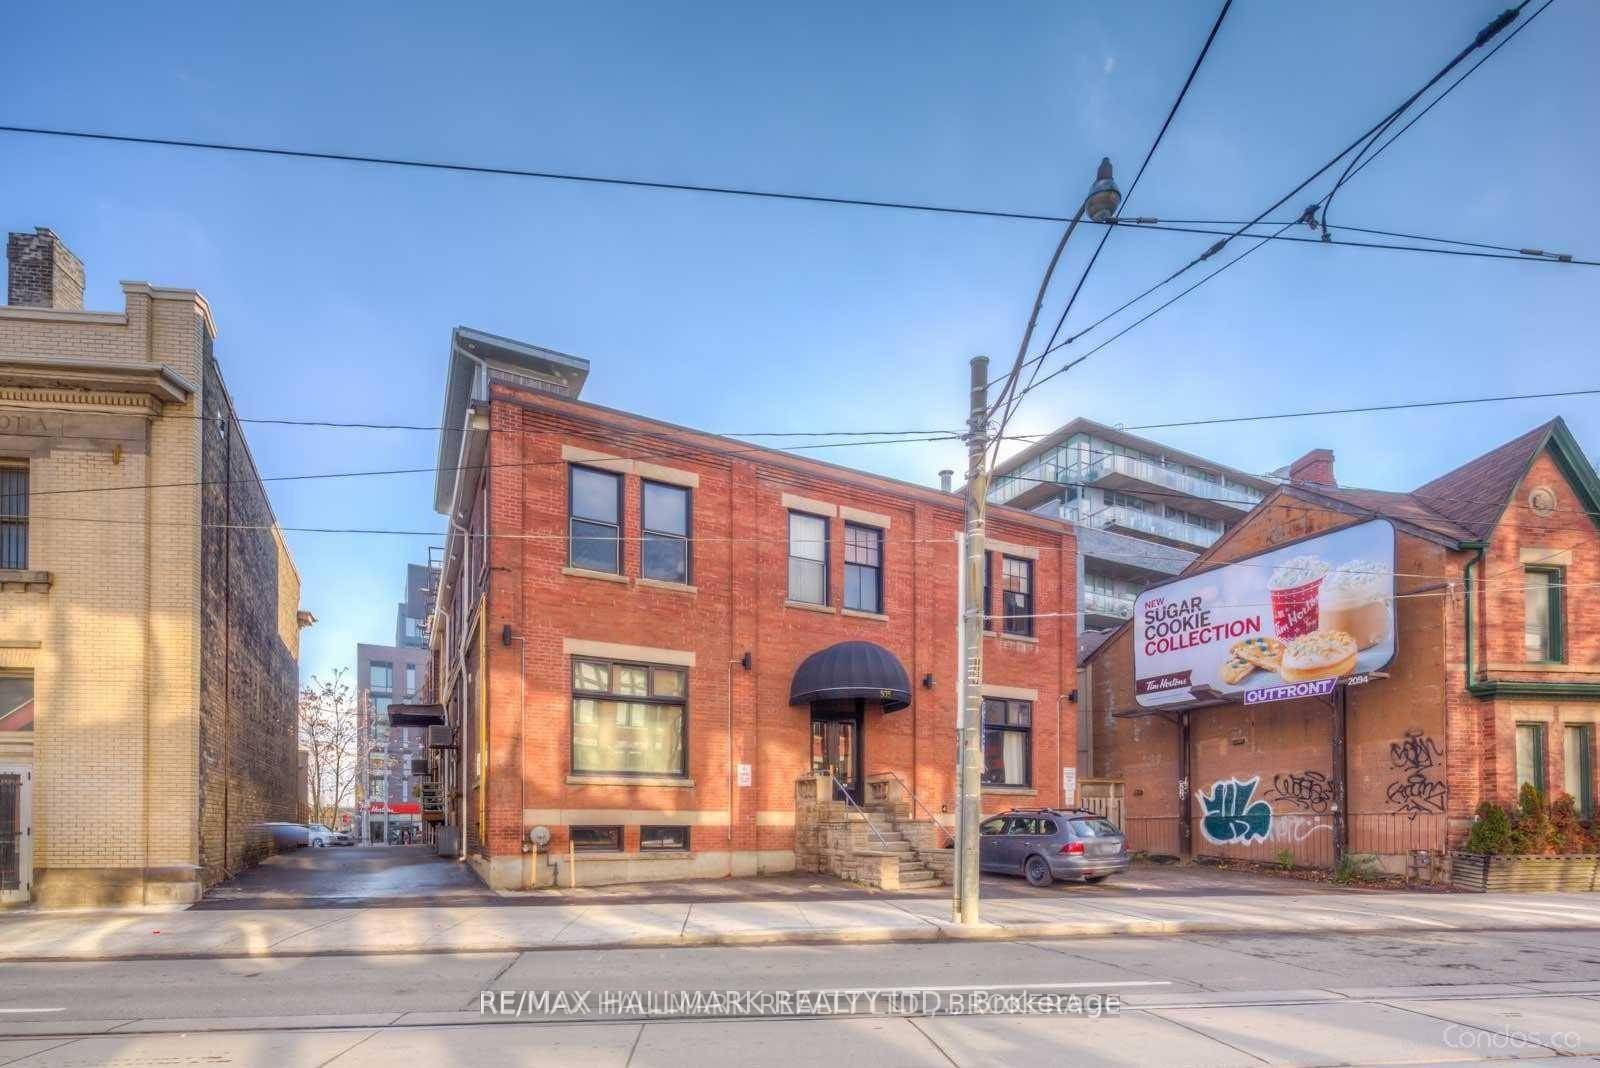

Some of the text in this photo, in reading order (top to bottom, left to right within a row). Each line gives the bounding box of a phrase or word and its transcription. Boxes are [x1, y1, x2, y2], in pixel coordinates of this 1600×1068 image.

[1145, 598, 1164, 609] NEW
[1145, 597, 1202, 625] SUGAR
[1145, 611, 1211, 641] COOKIE
[1145, 616, 1261, 656] COLLECTION
[1247, 680, 1332, 702] OUTFRONT
